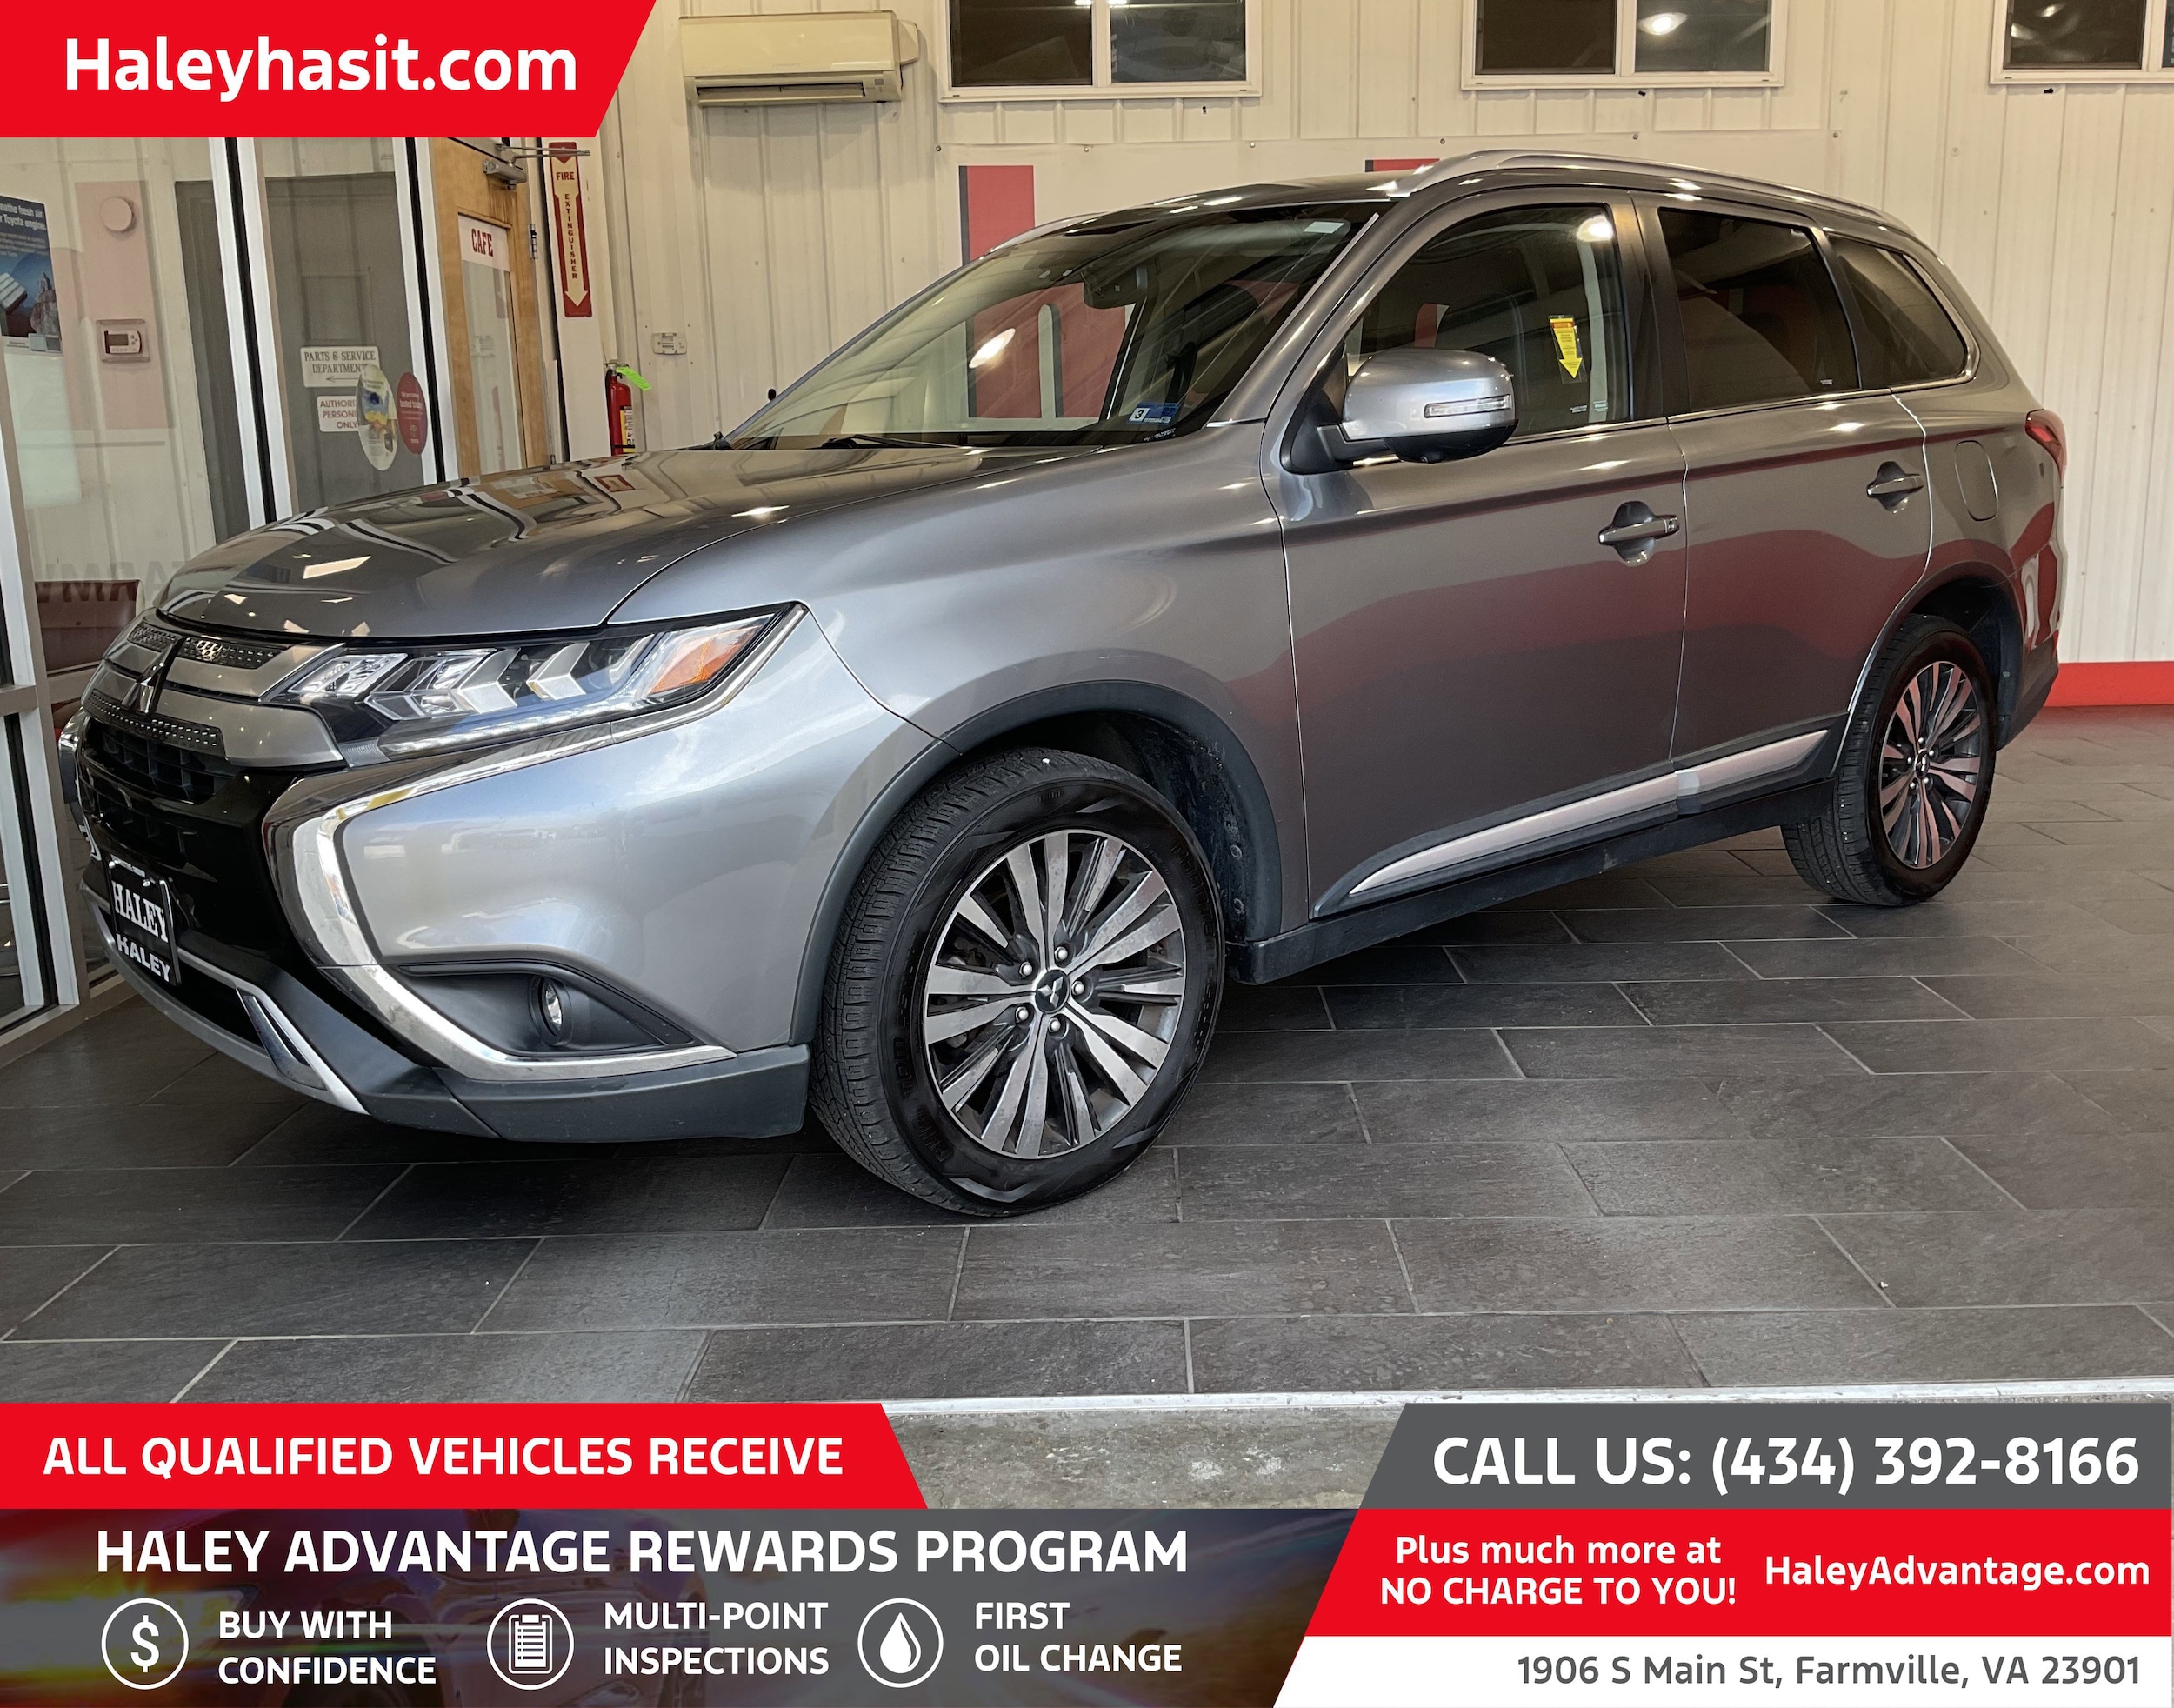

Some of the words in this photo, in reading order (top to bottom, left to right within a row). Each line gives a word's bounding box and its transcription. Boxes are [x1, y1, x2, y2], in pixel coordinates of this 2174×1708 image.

[556, 171, 575, 181] FIRE
[3, 214, 24, 226] Toyota
[564, 193, 578, 279] EXTINGUISHER
[471, 228, 493, 257] CAFE
[304, 350, 330, 362] PARTS
[332, 350, 338, 361] &
[341, 350, 376, 361] SERVICE
[320, 399, 356, 408] AUTHORI
[1134, 410, 1144, 419] 3
[110, 879, 169, 944] HALEY
[116, 932, 170, 983] HALEY
